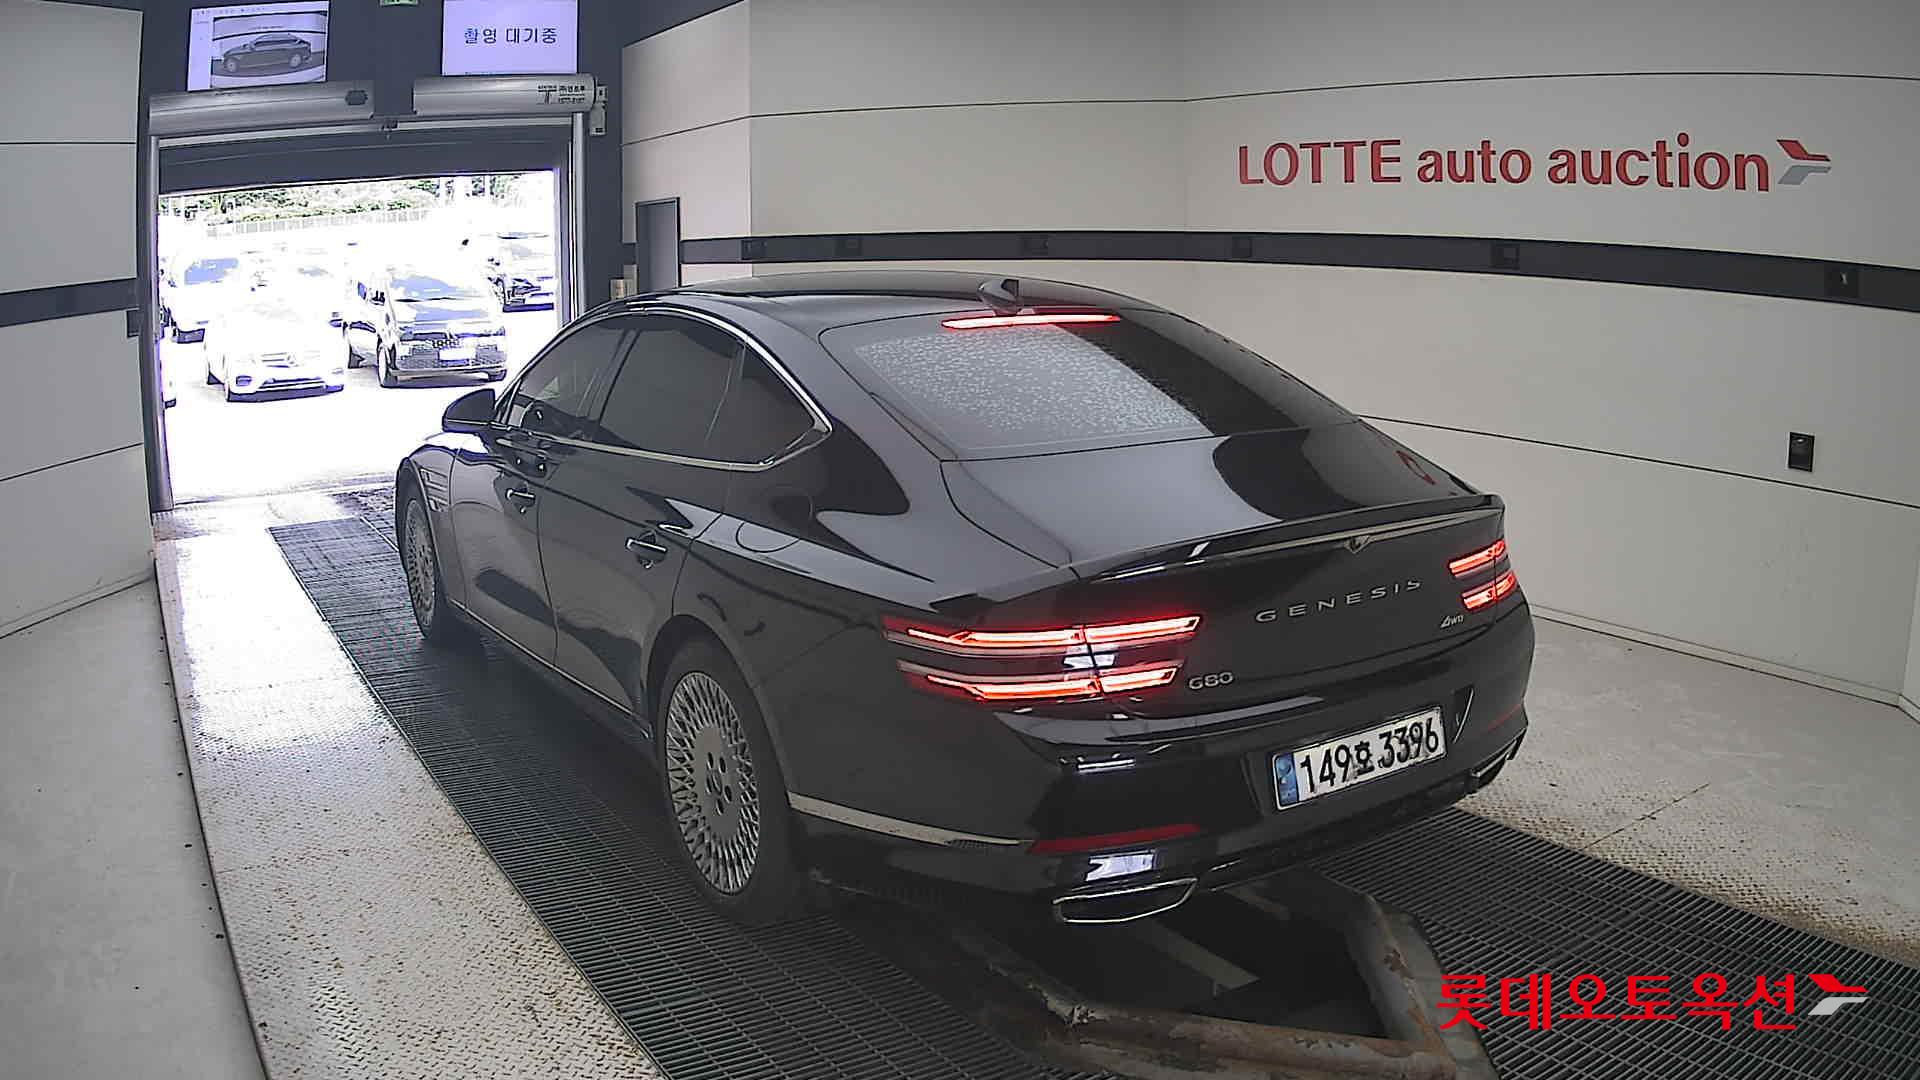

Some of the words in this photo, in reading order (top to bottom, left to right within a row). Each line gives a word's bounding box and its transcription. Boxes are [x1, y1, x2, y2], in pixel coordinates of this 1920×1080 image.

[505, 27, 558, 44] 대기중
[1239, 139, 1402, 185] LOTTE
[1417, 140, 1532, 184] auto
[1548, 132, 1769, 193] auction
[1255, 579, 1422, 622] GENESIS
[1188, 671, 1234, 690] G80
